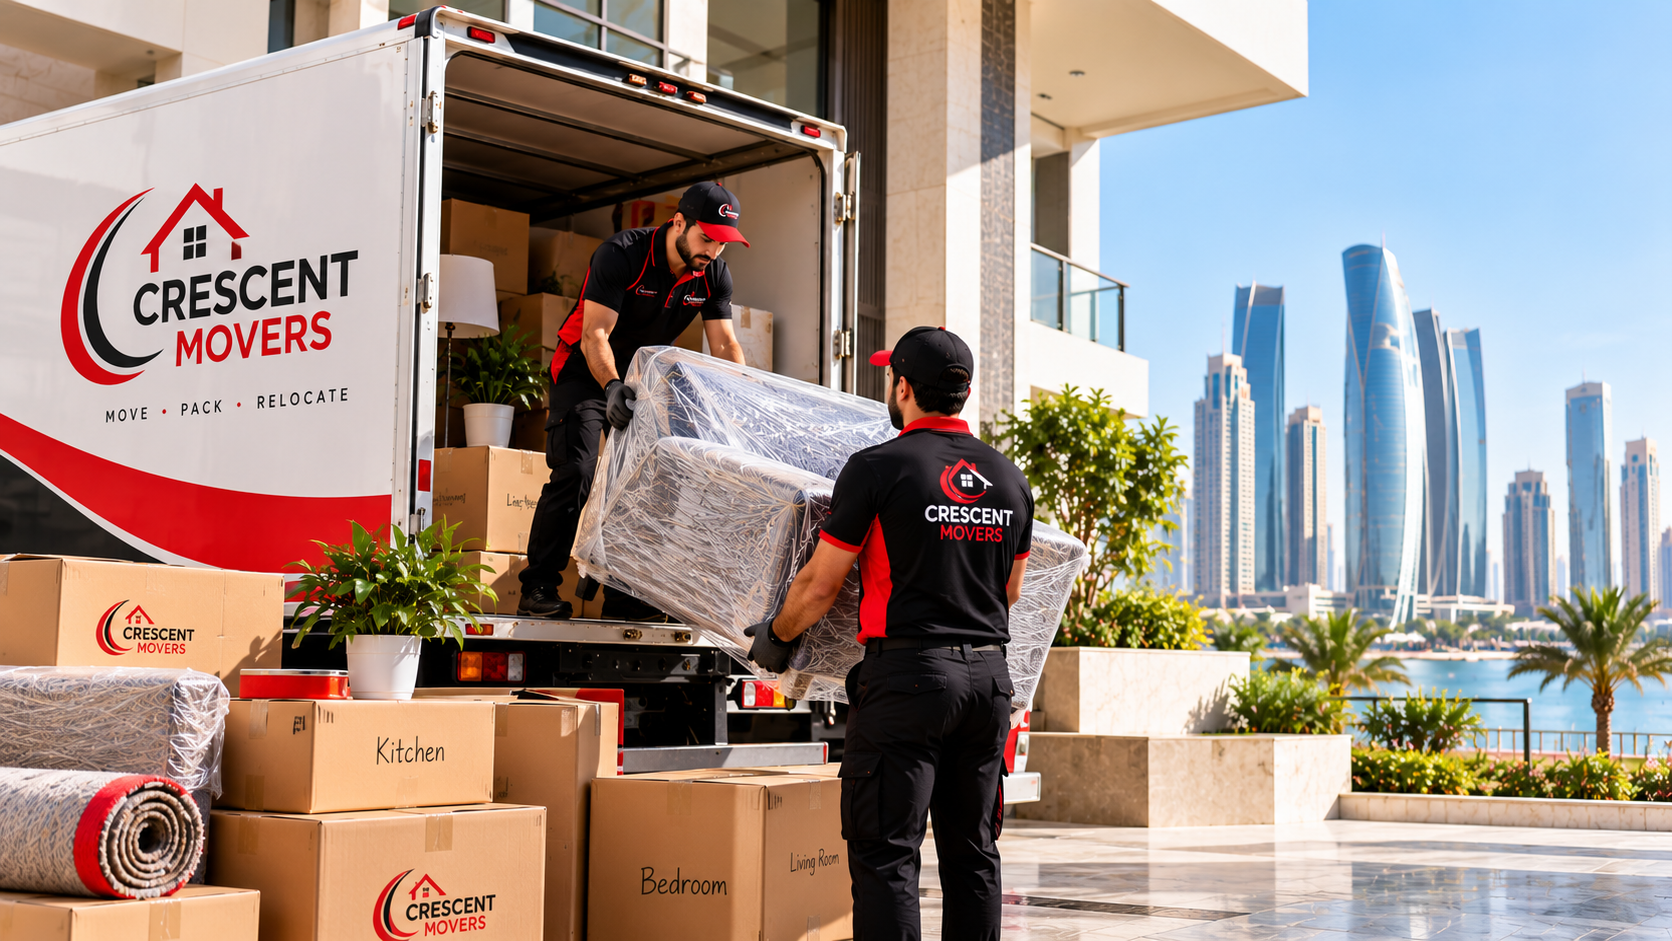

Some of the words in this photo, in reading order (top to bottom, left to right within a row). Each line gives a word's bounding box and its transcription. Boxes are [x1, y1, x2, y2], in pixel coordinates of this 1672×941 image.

[133, 250, 359, 326] CRESCENT
[175, 310, 333, 367] MOVERS
[105, 407, 149, 423] MOVE
[181, 399, 223, 416] PACK
[256, 388, 349, 410] RELOCATE
[924, 504, 1014, 527] CRESCENT
[940, 524, 1003, 543] MOVERS
[122, 626, 195, 642] CRESCENT
[137, 642, 186, 655] MOVERS
[376, 735, 445, 765] Kitchen
[789, 852, 816, 876] Living
[818, 848, 840, 868] Room
[640, 866, 728, 896] Bedroom
[405, 894, 496, 922] CRESCENT
[424, 915, 487, 937] MOVERS
